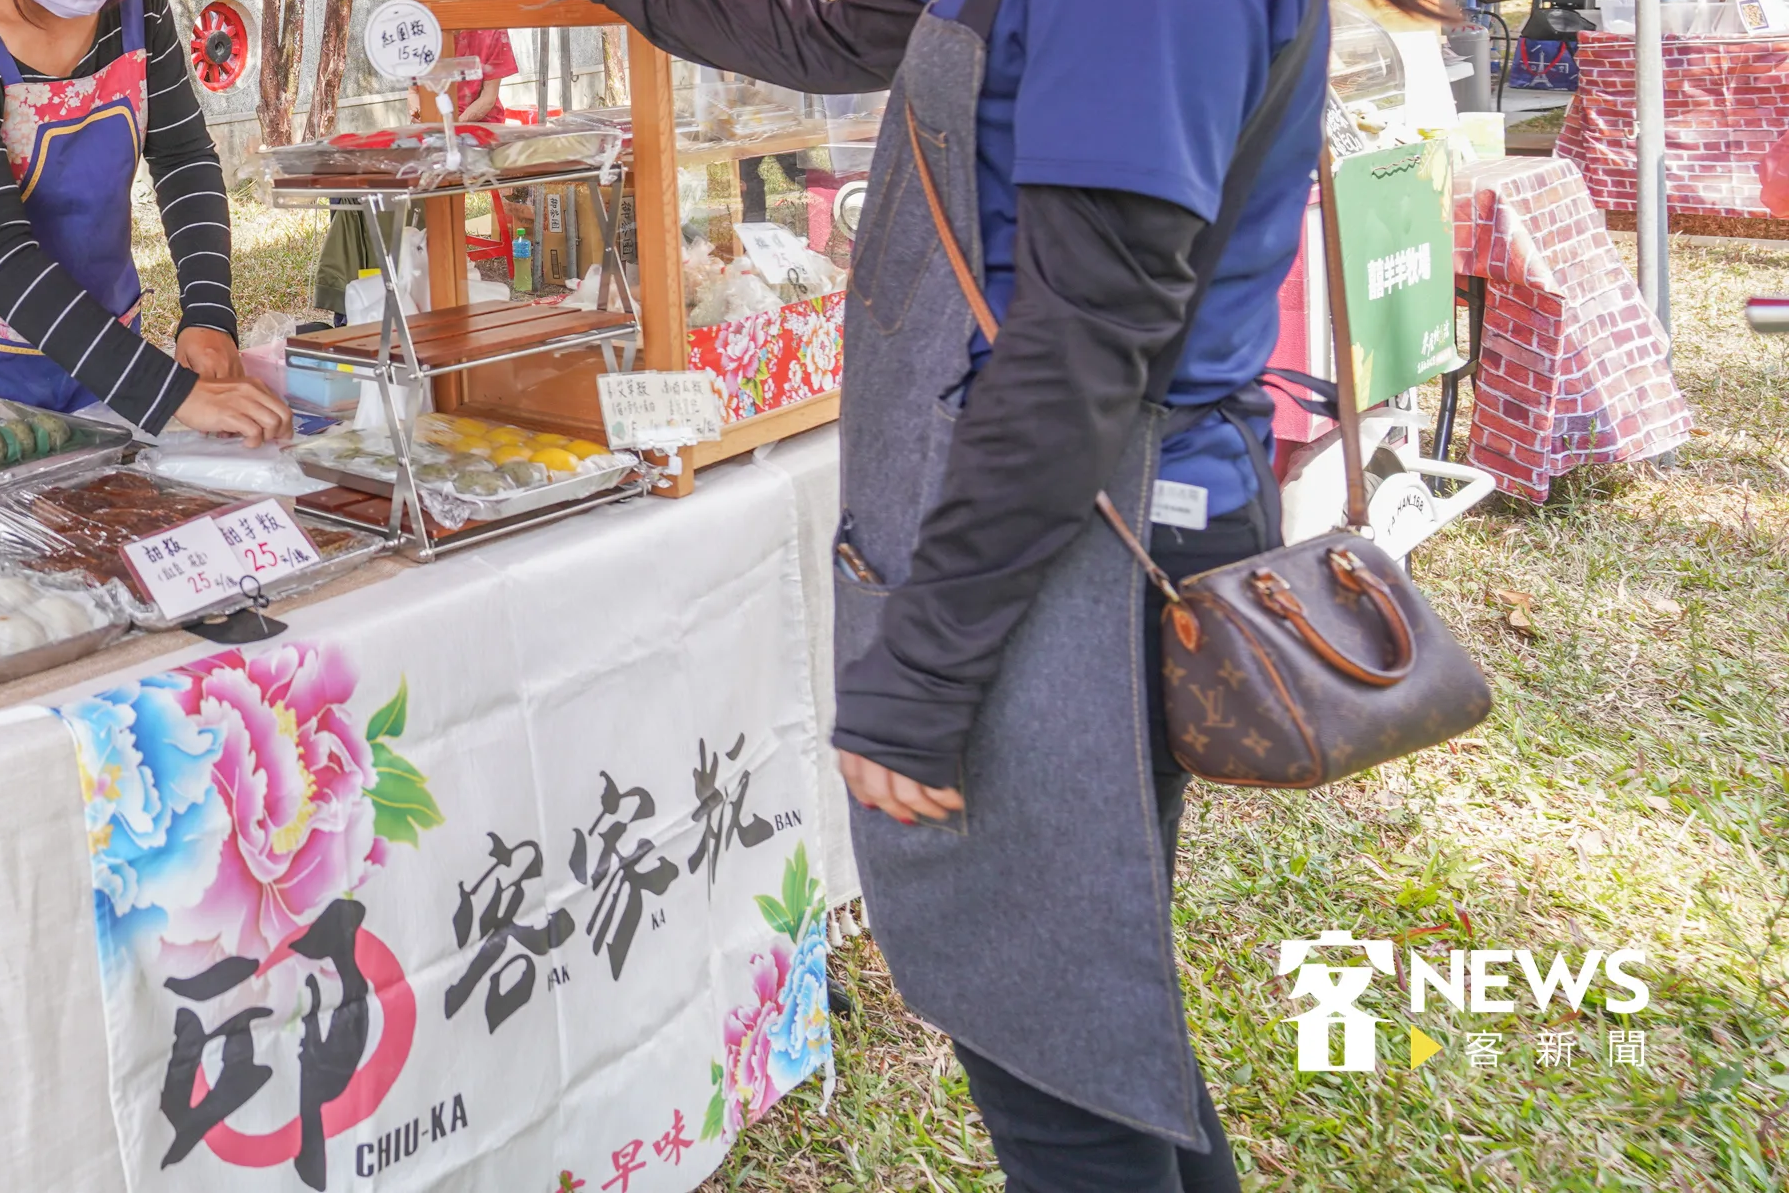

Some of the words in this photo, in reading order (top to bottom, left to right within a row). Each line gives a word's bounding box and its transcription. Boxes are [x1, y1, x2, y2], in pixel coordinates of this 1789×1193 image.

[774, 809, 803, 833] BAN
[651, 908, 667, 931] KA
[355, 1092, 468, 1178] CHIU-KA
